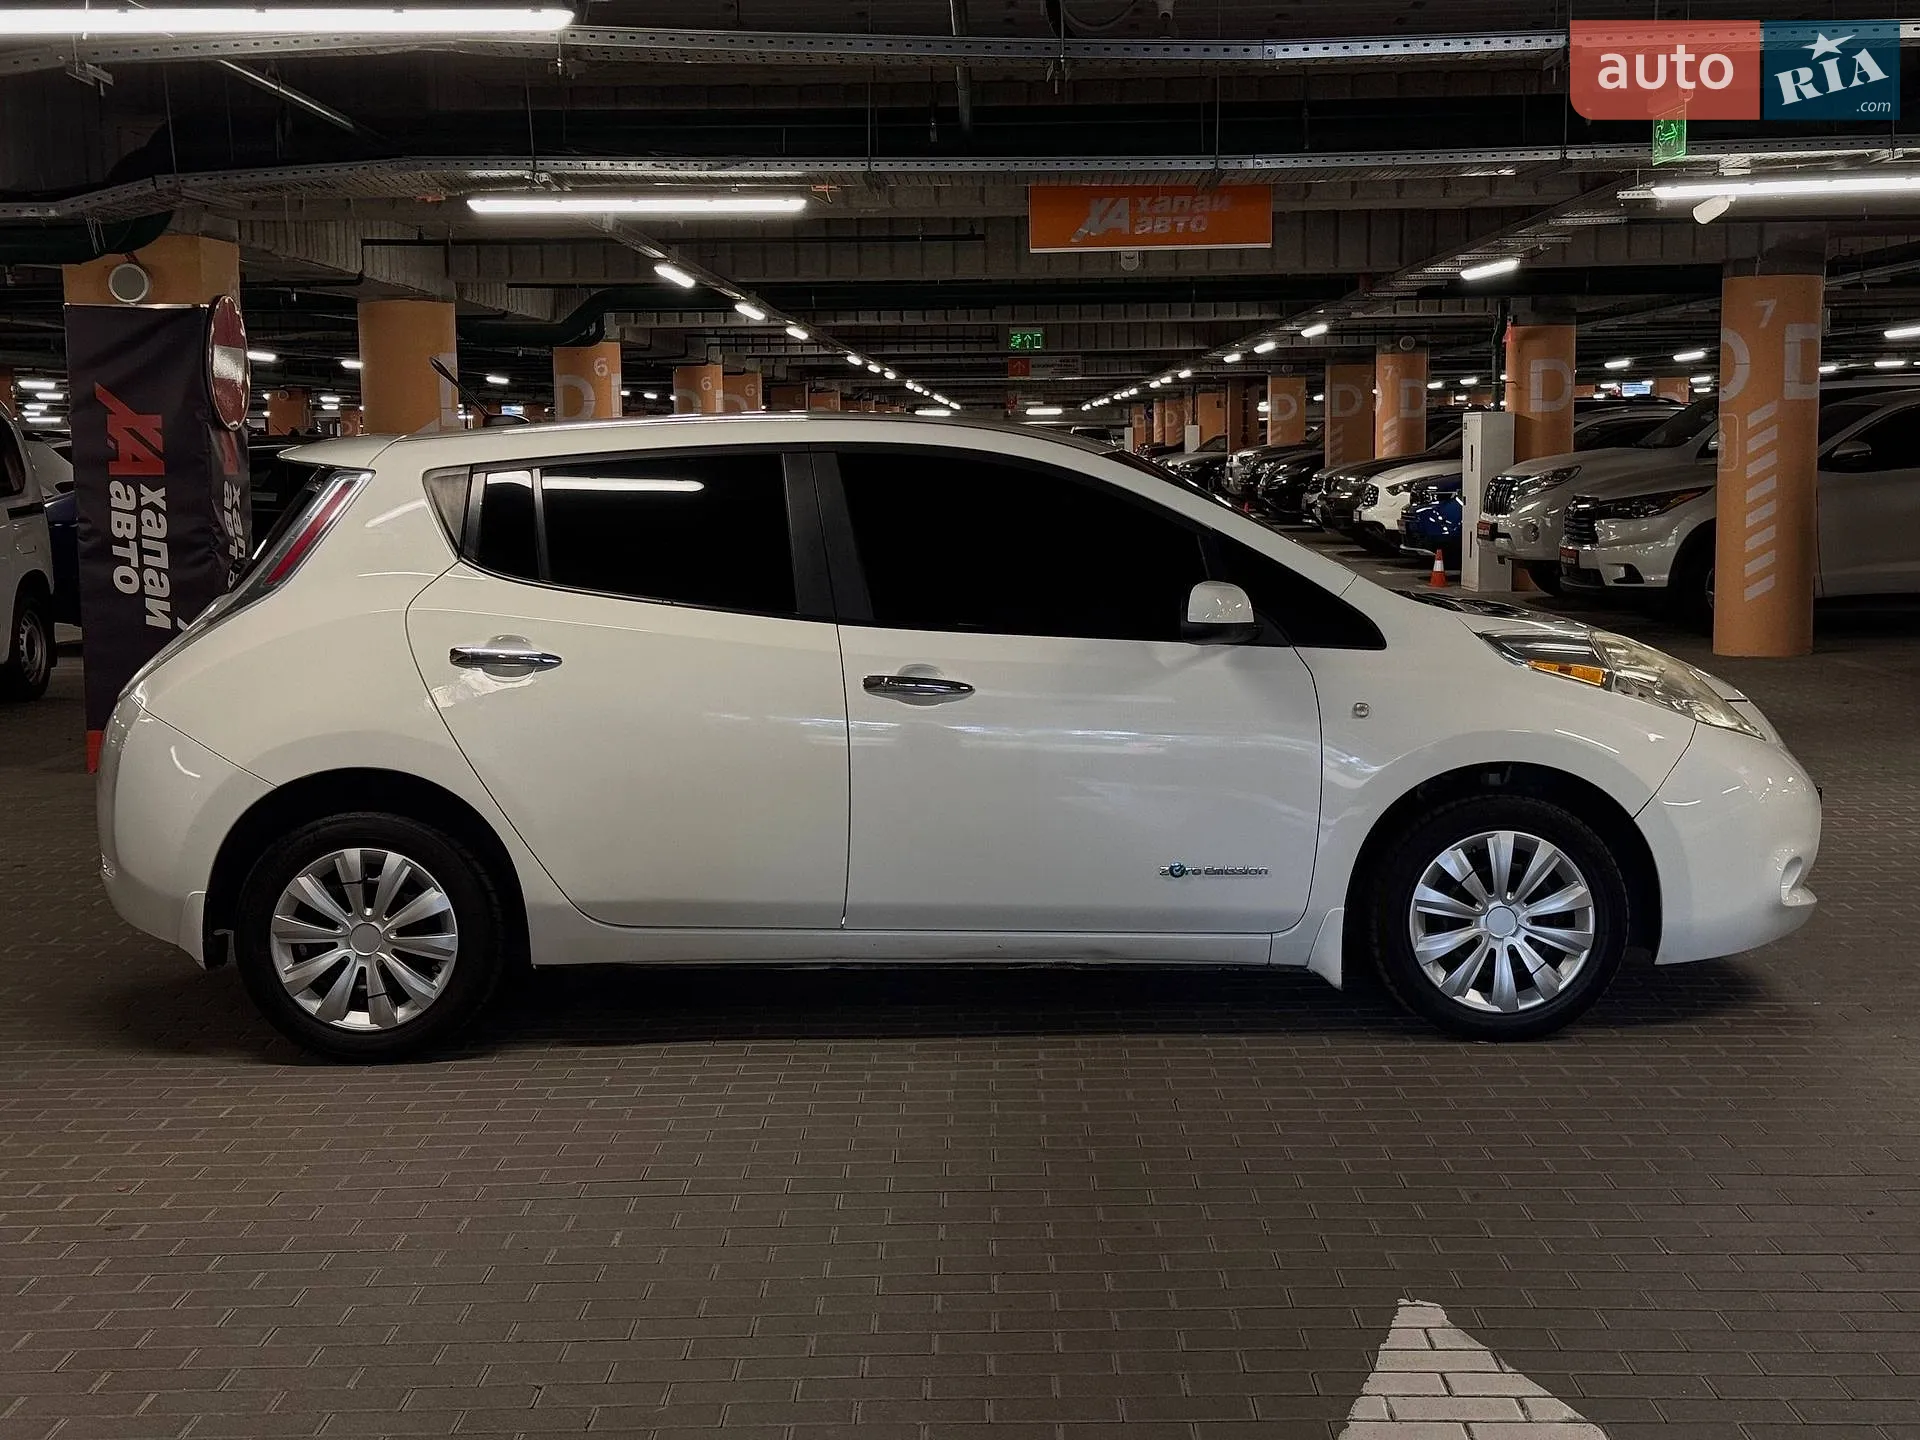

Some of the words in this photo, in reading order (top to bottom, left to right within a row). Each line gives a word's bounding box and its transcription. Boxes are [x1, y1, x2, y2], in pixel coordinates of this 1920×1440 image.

[1135, 215, 1208, 234] авто
[1756, 299, 1777, 329] 7
[593, 357, 609, 377] 6
[1384, 365, 1394, 381] 7
[700, 376, 712, 391] 6
[745, 383, 757, 397] 6
[1530, 358, 1574, 413] D
[1271, 393, 1298, 421] D
[1331, 383, 1363, 417] D
[1401, 378, 1427, 418] D
[109, 480, 140, 595] авто
